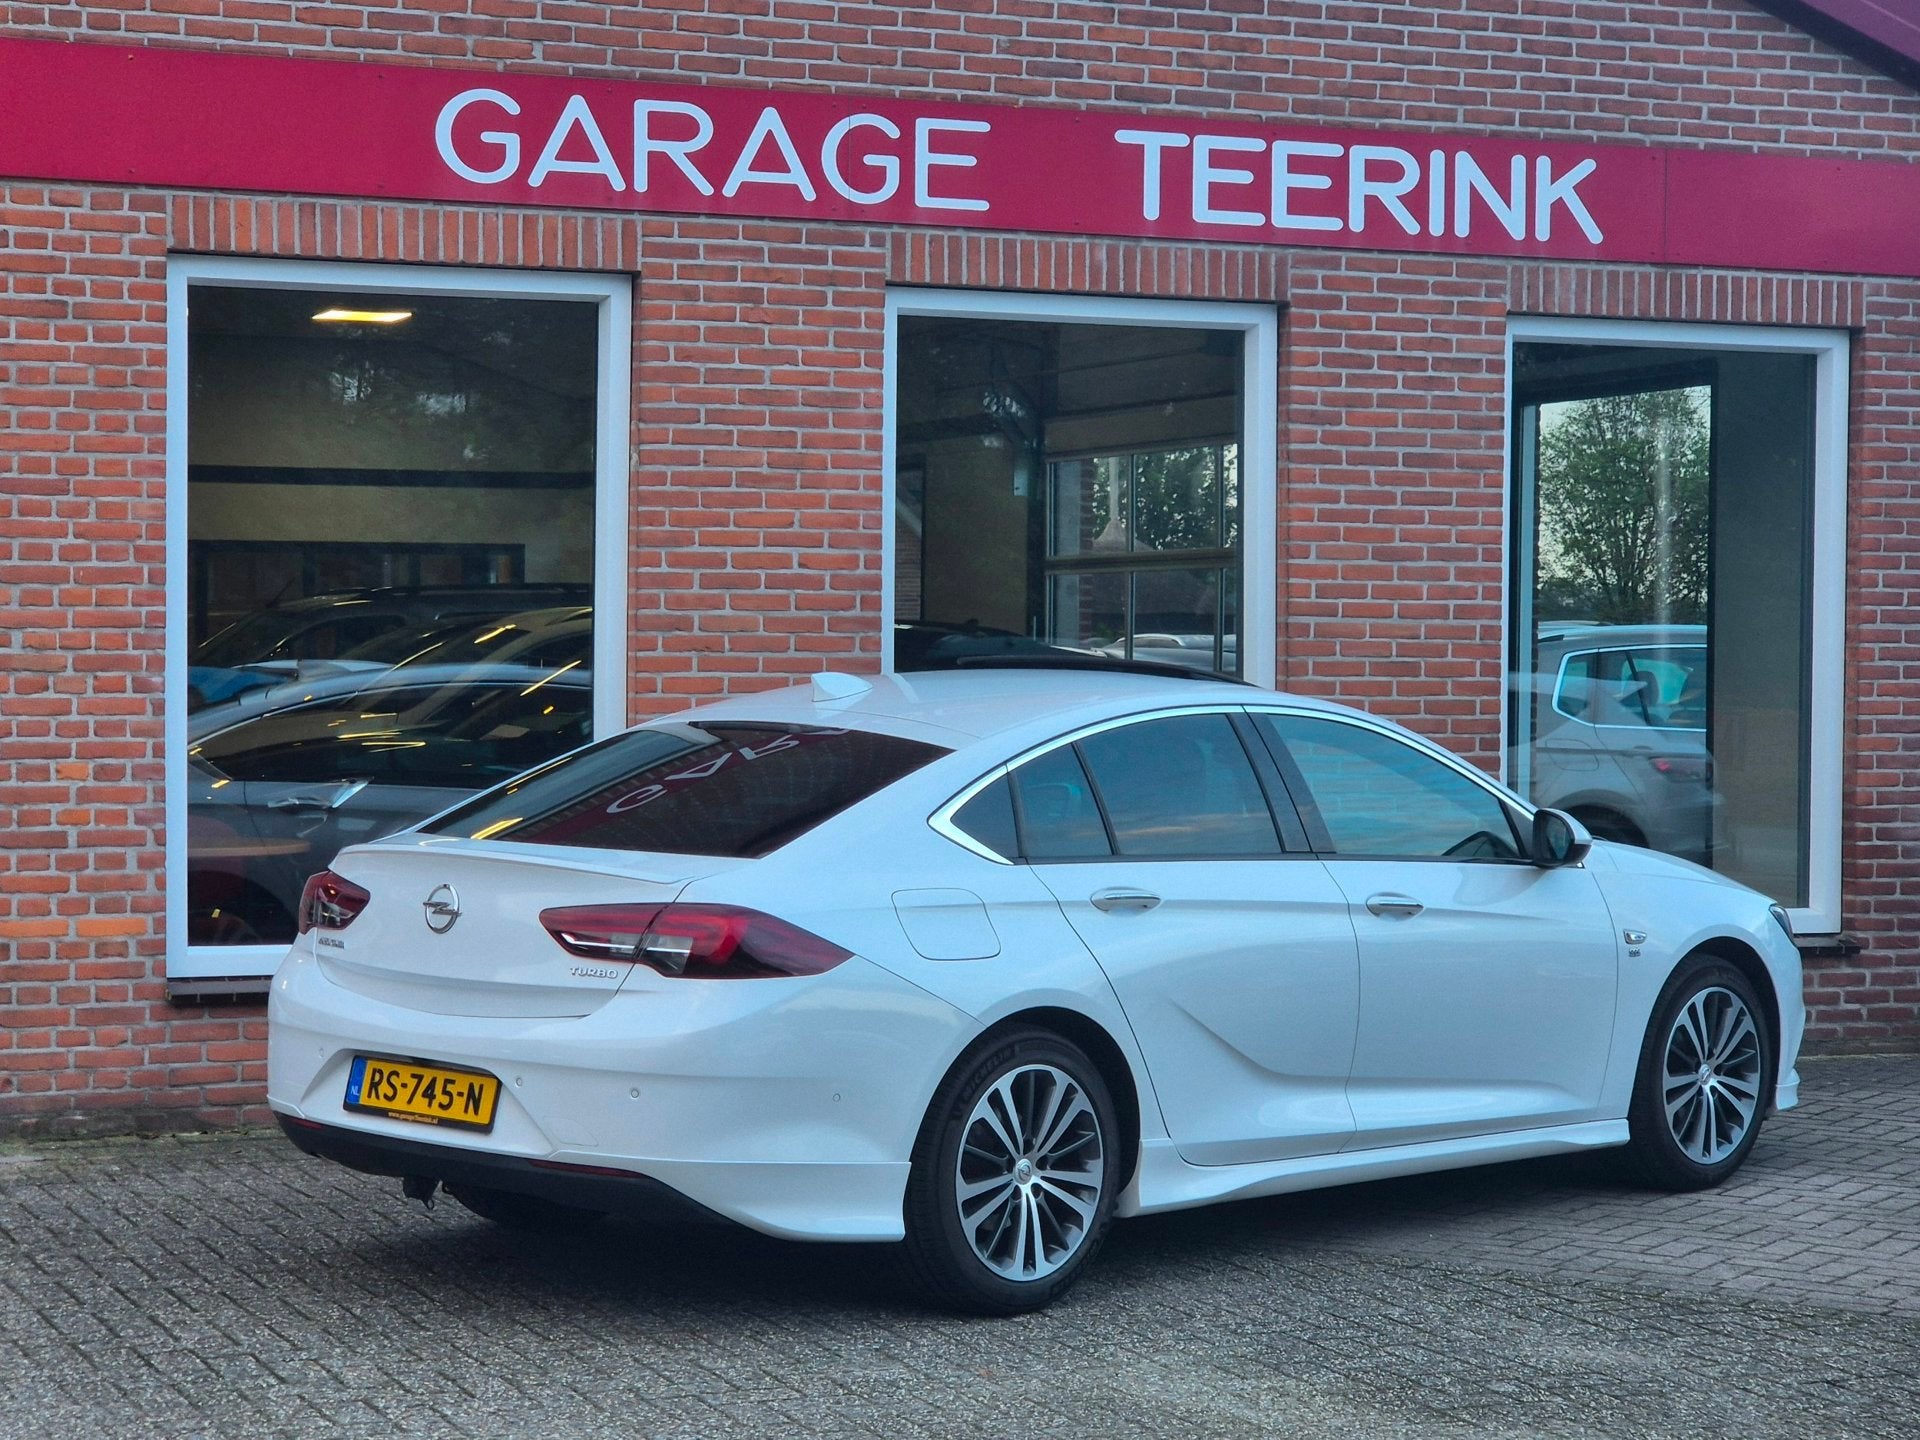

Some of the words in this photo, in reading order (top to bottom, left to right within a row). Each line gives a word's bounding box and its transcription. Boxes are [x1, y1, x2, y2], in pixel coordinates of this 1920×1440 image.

[435, 88, 991, 212] GARAGE
[1114, 129, 1604, 245] TEERINK
[569, 966, 619, 980] TURBO
[350, 1085, 360, 1096] NL
[367, 1067, 485, 1117] RS-745-N
